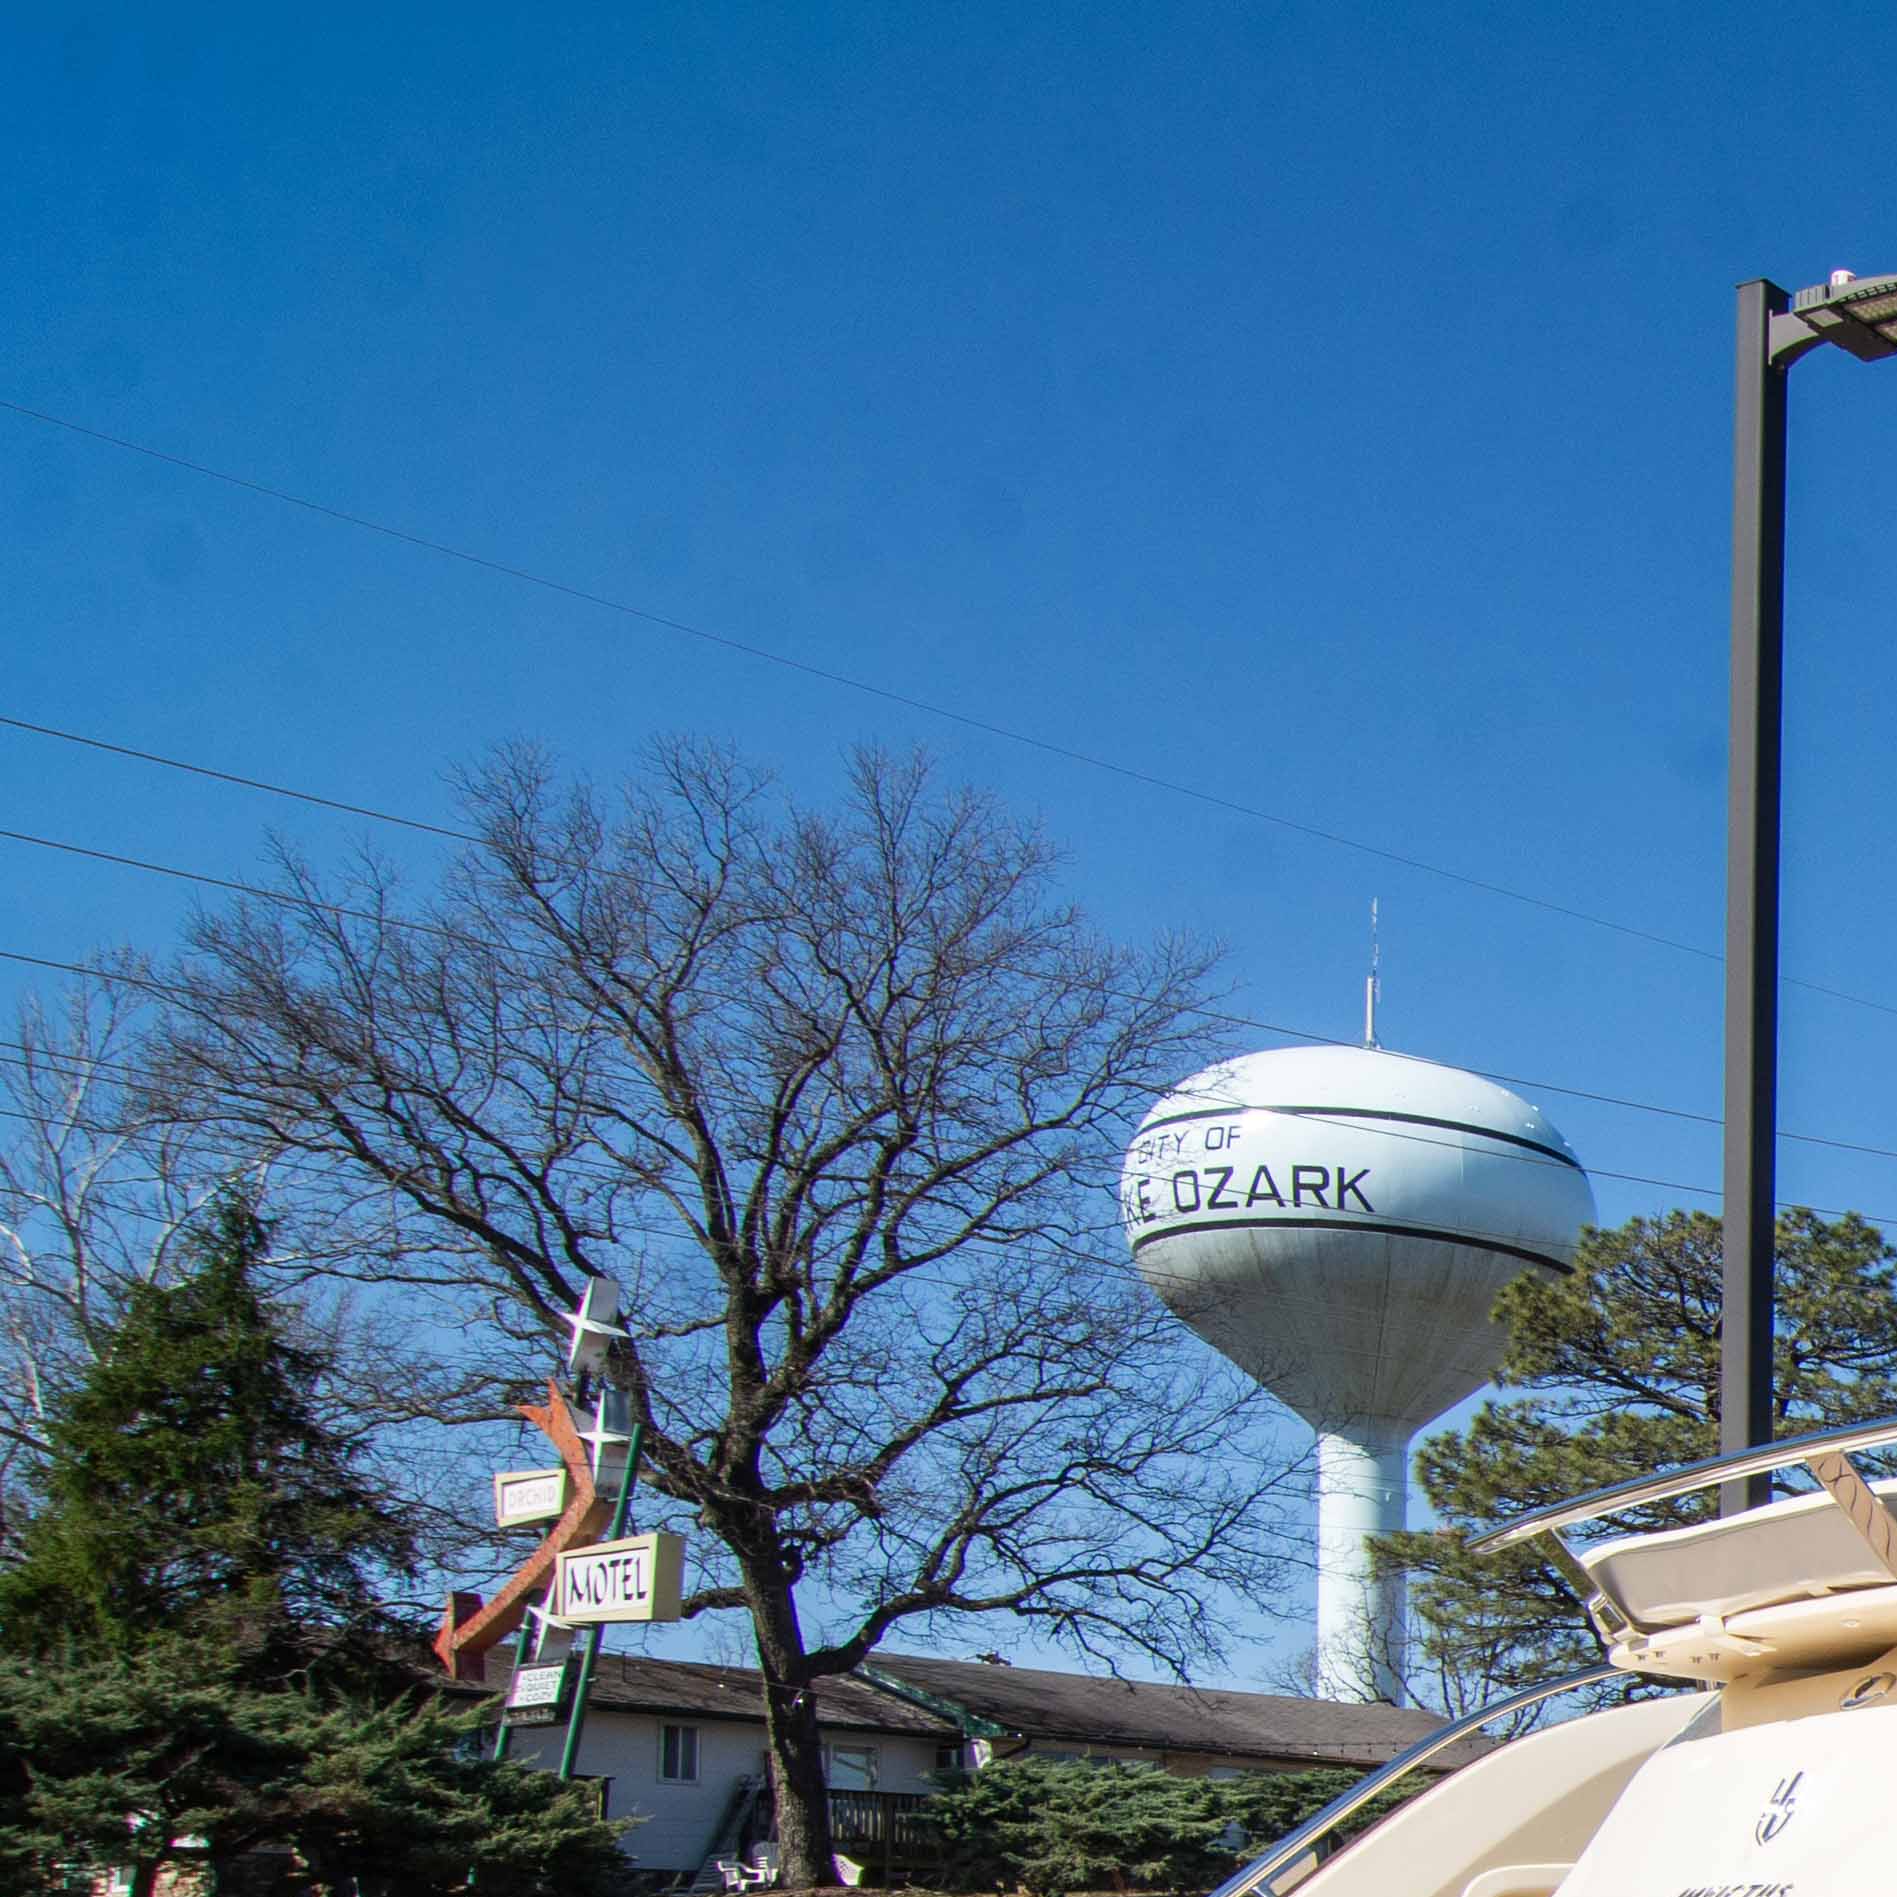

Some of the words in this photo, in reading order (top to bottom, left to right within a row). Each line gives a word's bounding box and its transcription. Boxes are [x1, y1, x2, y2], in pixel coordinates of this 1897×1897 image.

[1138, 1129, 1191, 1164] CITY
[1205, 1125, 1242, 1151] OF
[1173, 1165, 1375, 1213] OZARK
[568, 1557, 649, 1606] MOTEL
